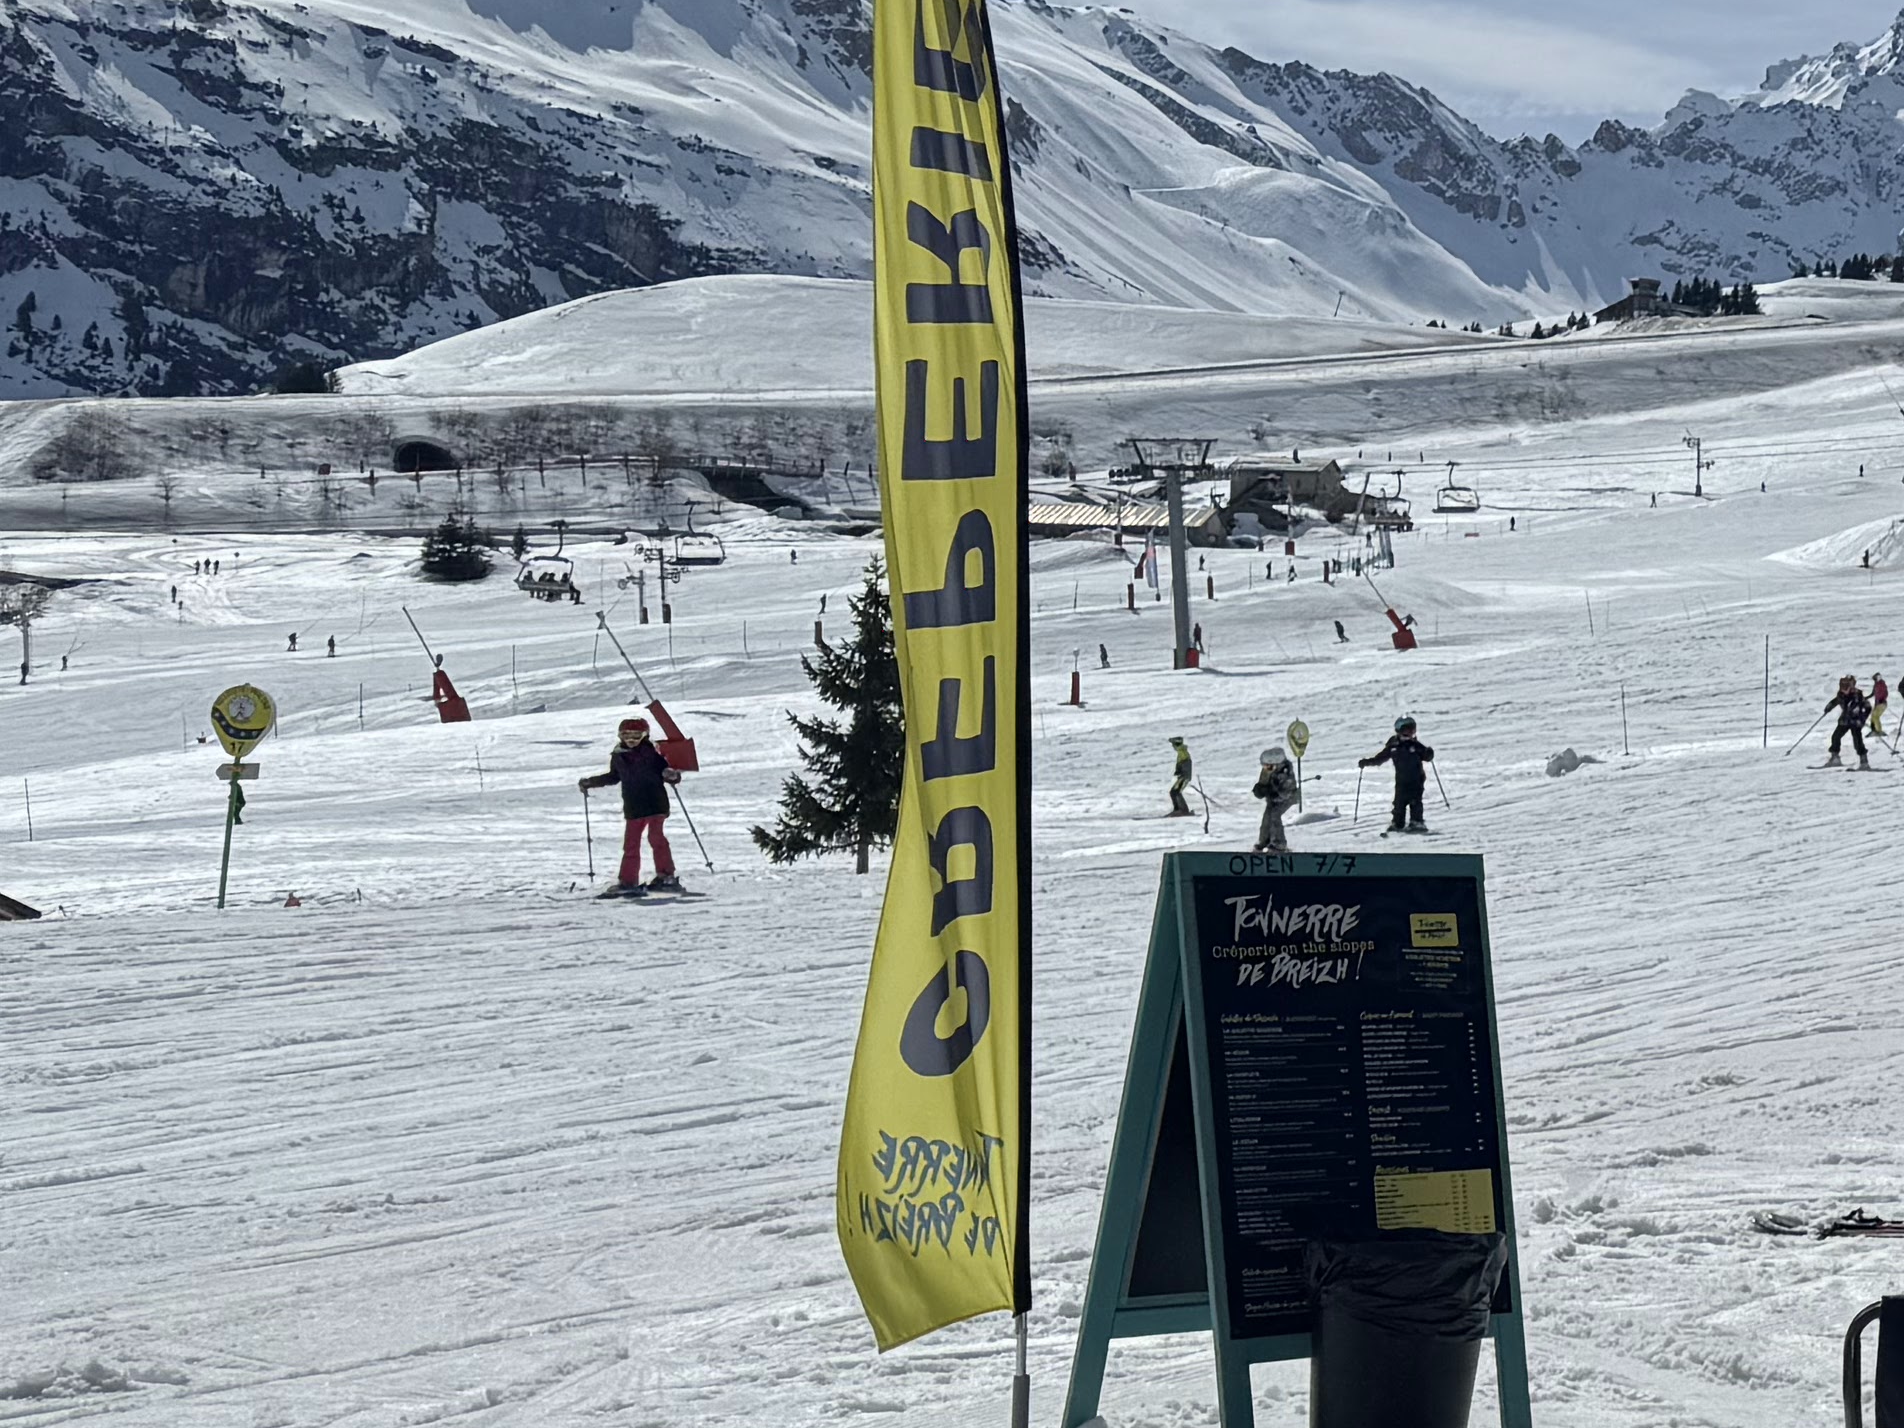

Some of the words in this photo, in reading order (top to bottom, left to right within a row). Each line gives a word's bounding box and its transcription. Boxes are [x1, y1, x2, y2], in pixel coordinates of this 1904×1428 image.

[1228, 855, 1294, 875] OPEN
[1313, 854, 1357, 873] 7/7
[1281, 944, 1298, 955] on
[1302, 941, 1326, 954] the
[1330, 940, 1375, 954] slopes
